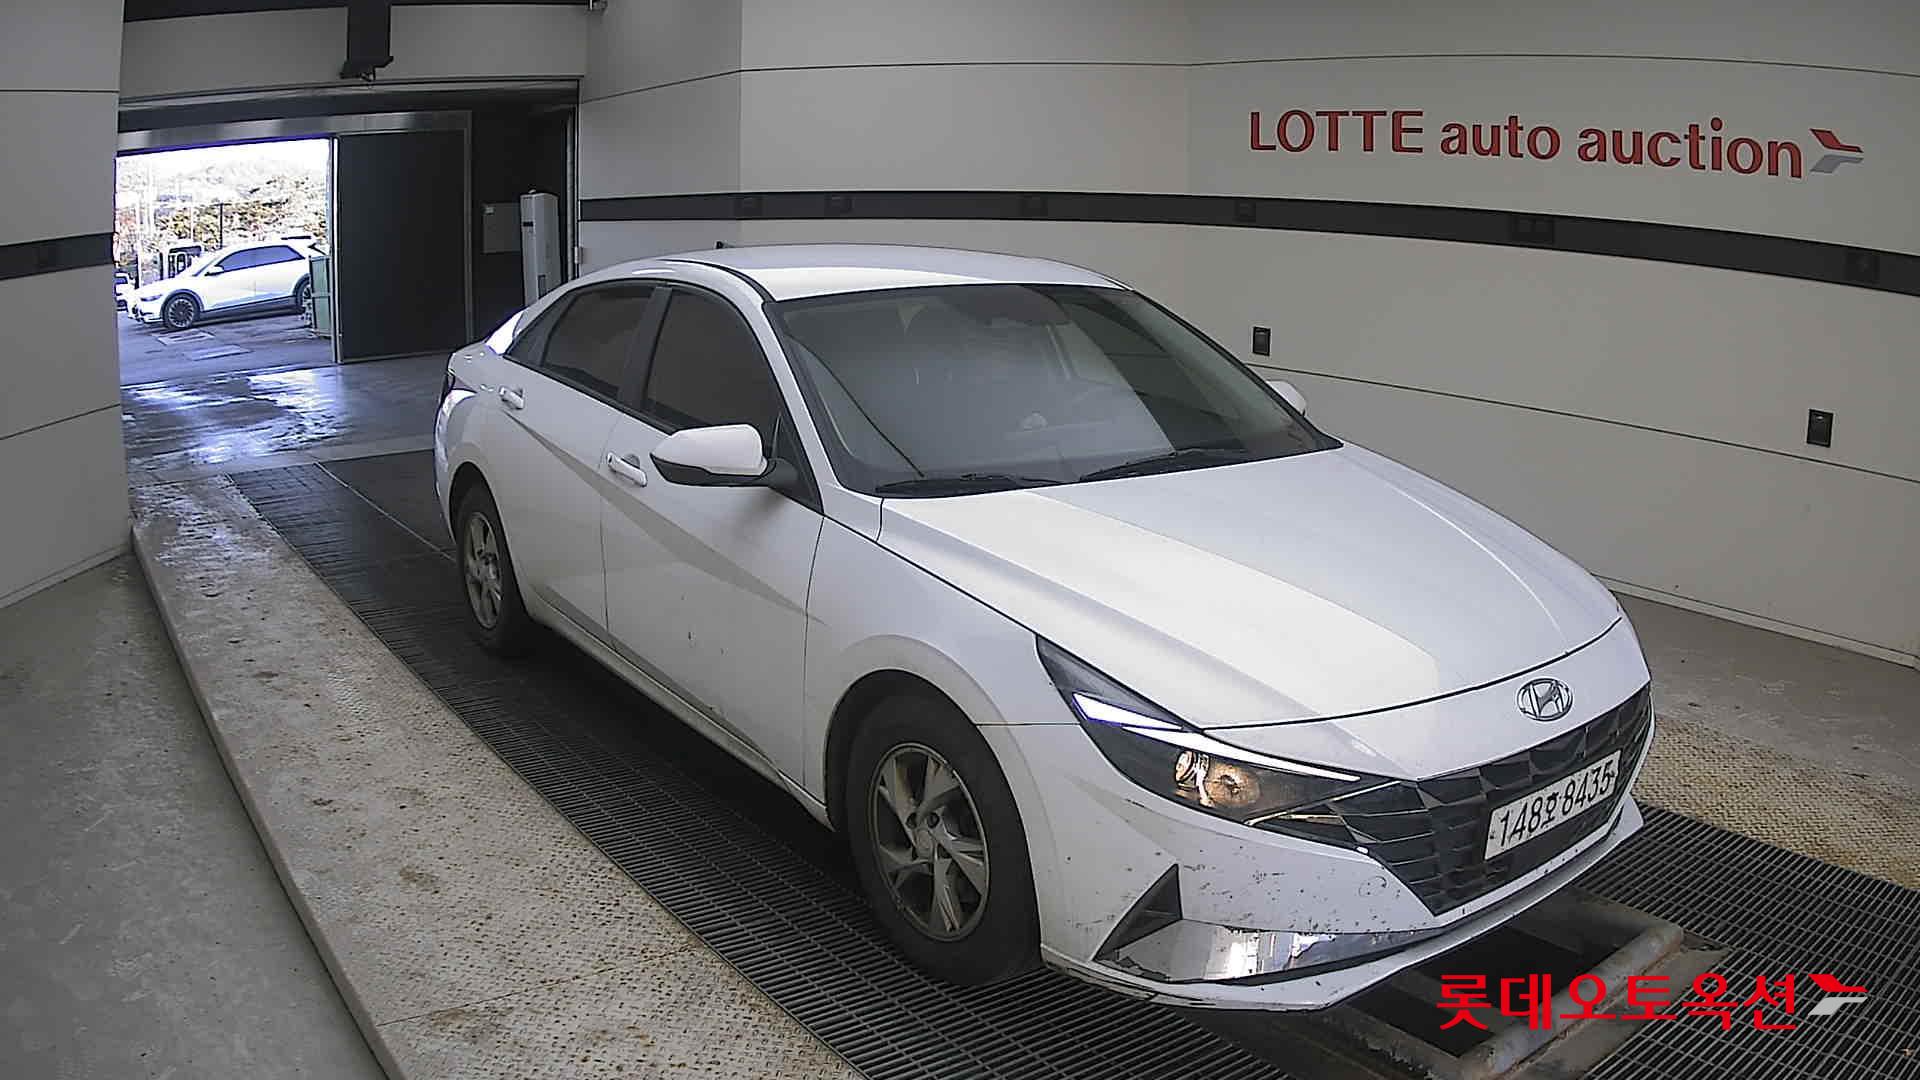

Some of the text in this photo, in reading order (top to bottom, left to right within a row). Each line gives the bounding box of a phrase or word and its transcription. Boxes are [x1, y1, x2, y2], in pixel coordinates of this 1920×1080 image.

[1249, 110, 1803, 179] LOTTE auto auction
